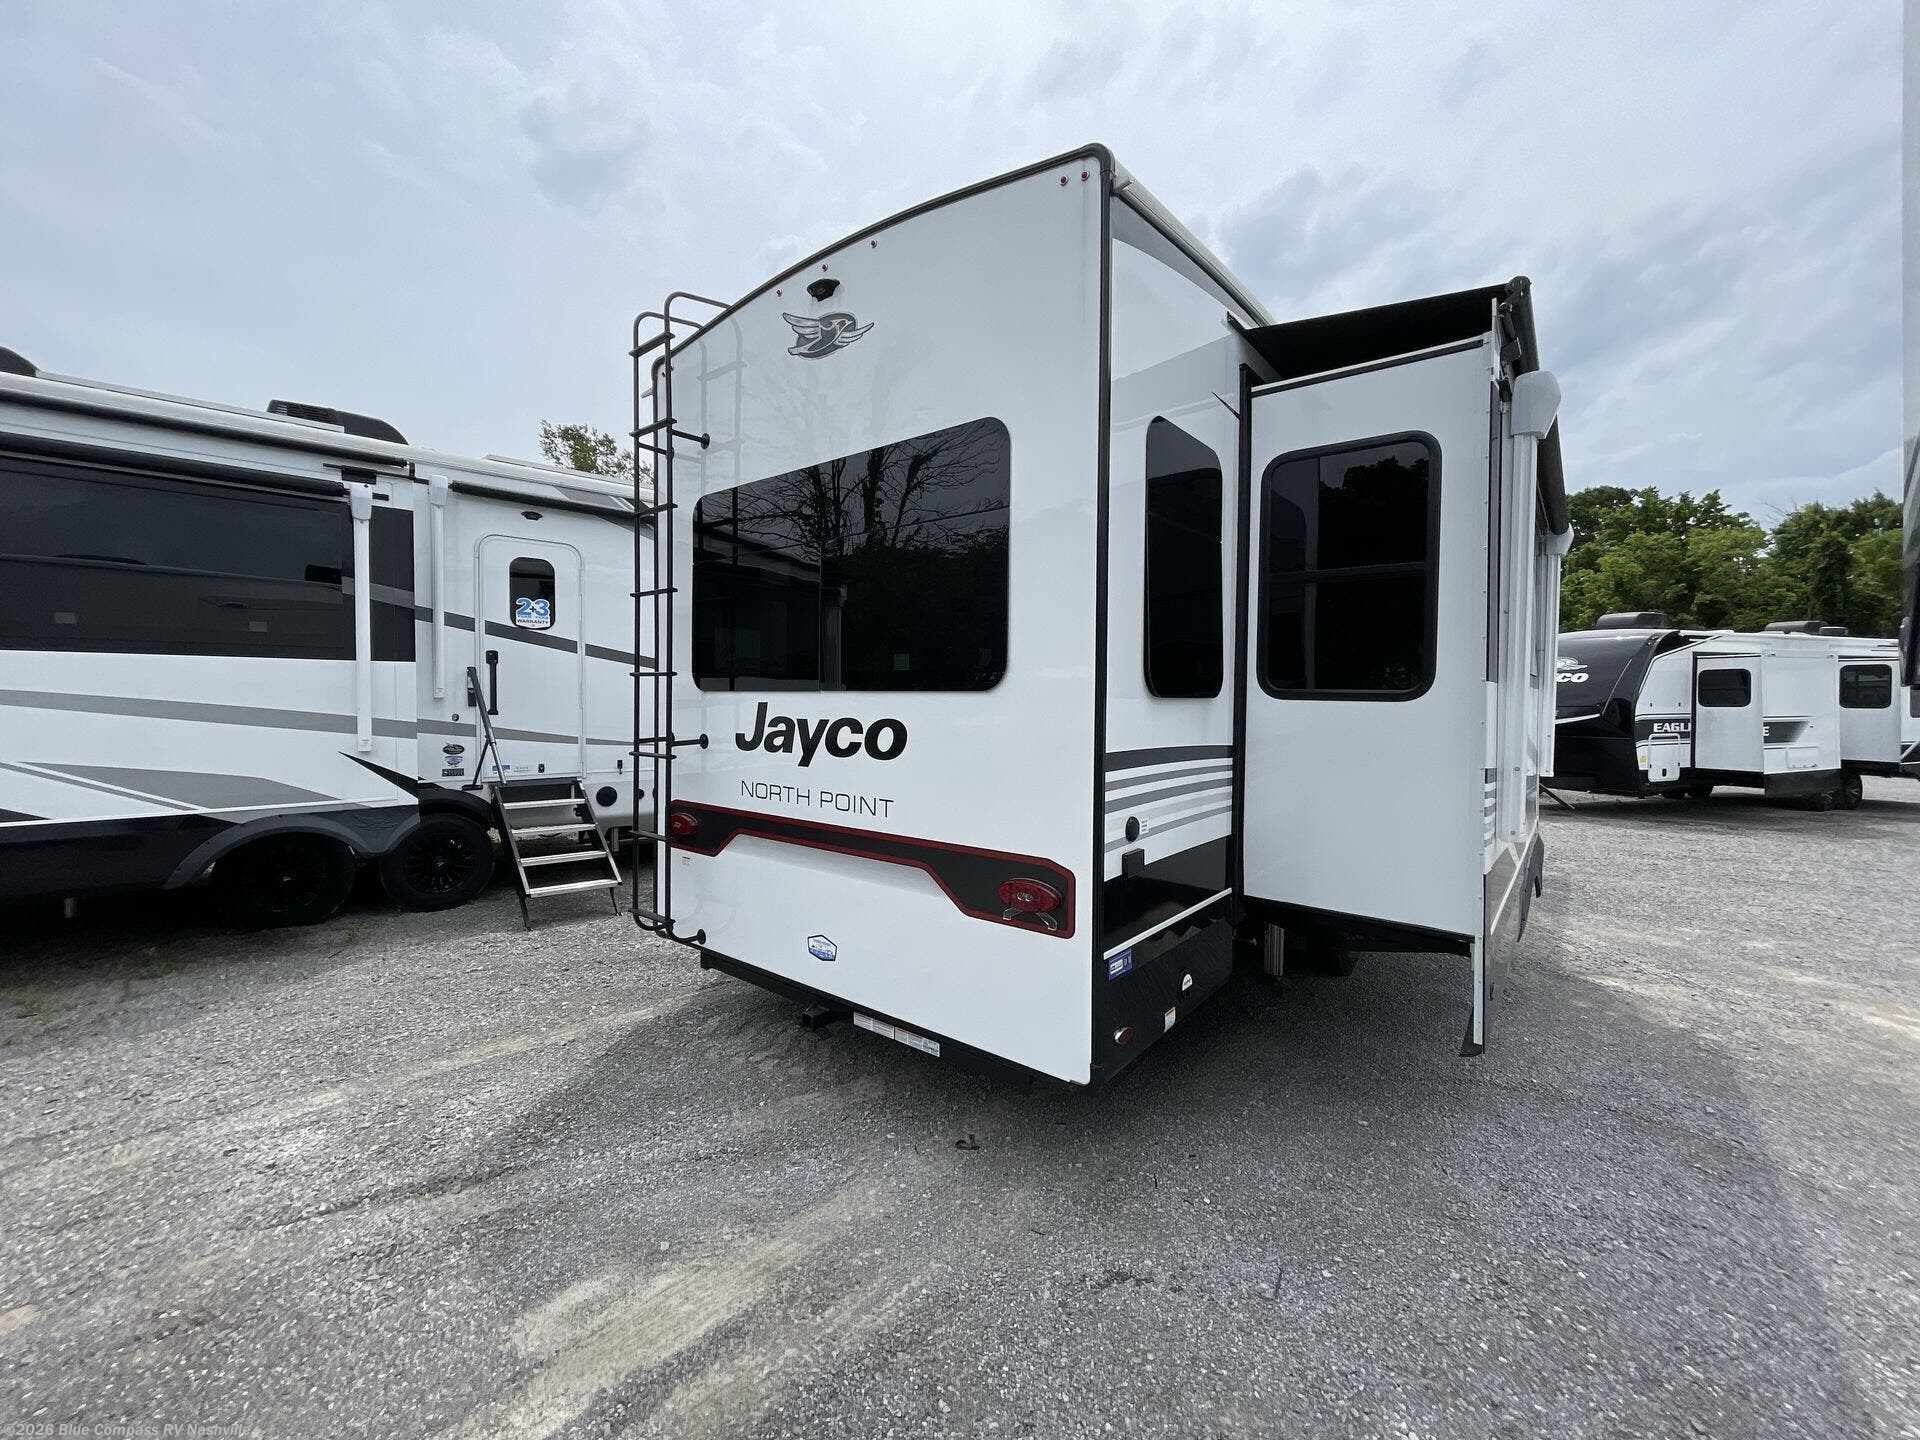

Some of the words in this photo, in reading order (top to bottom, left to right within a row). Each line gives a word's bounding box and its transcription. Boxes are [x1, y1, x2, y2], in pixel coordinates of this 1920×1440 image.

[735, 701, 908, 768] Jayco
[741, 780, 811, 807] NORTH
[820, 791, 895, 818] POINT
